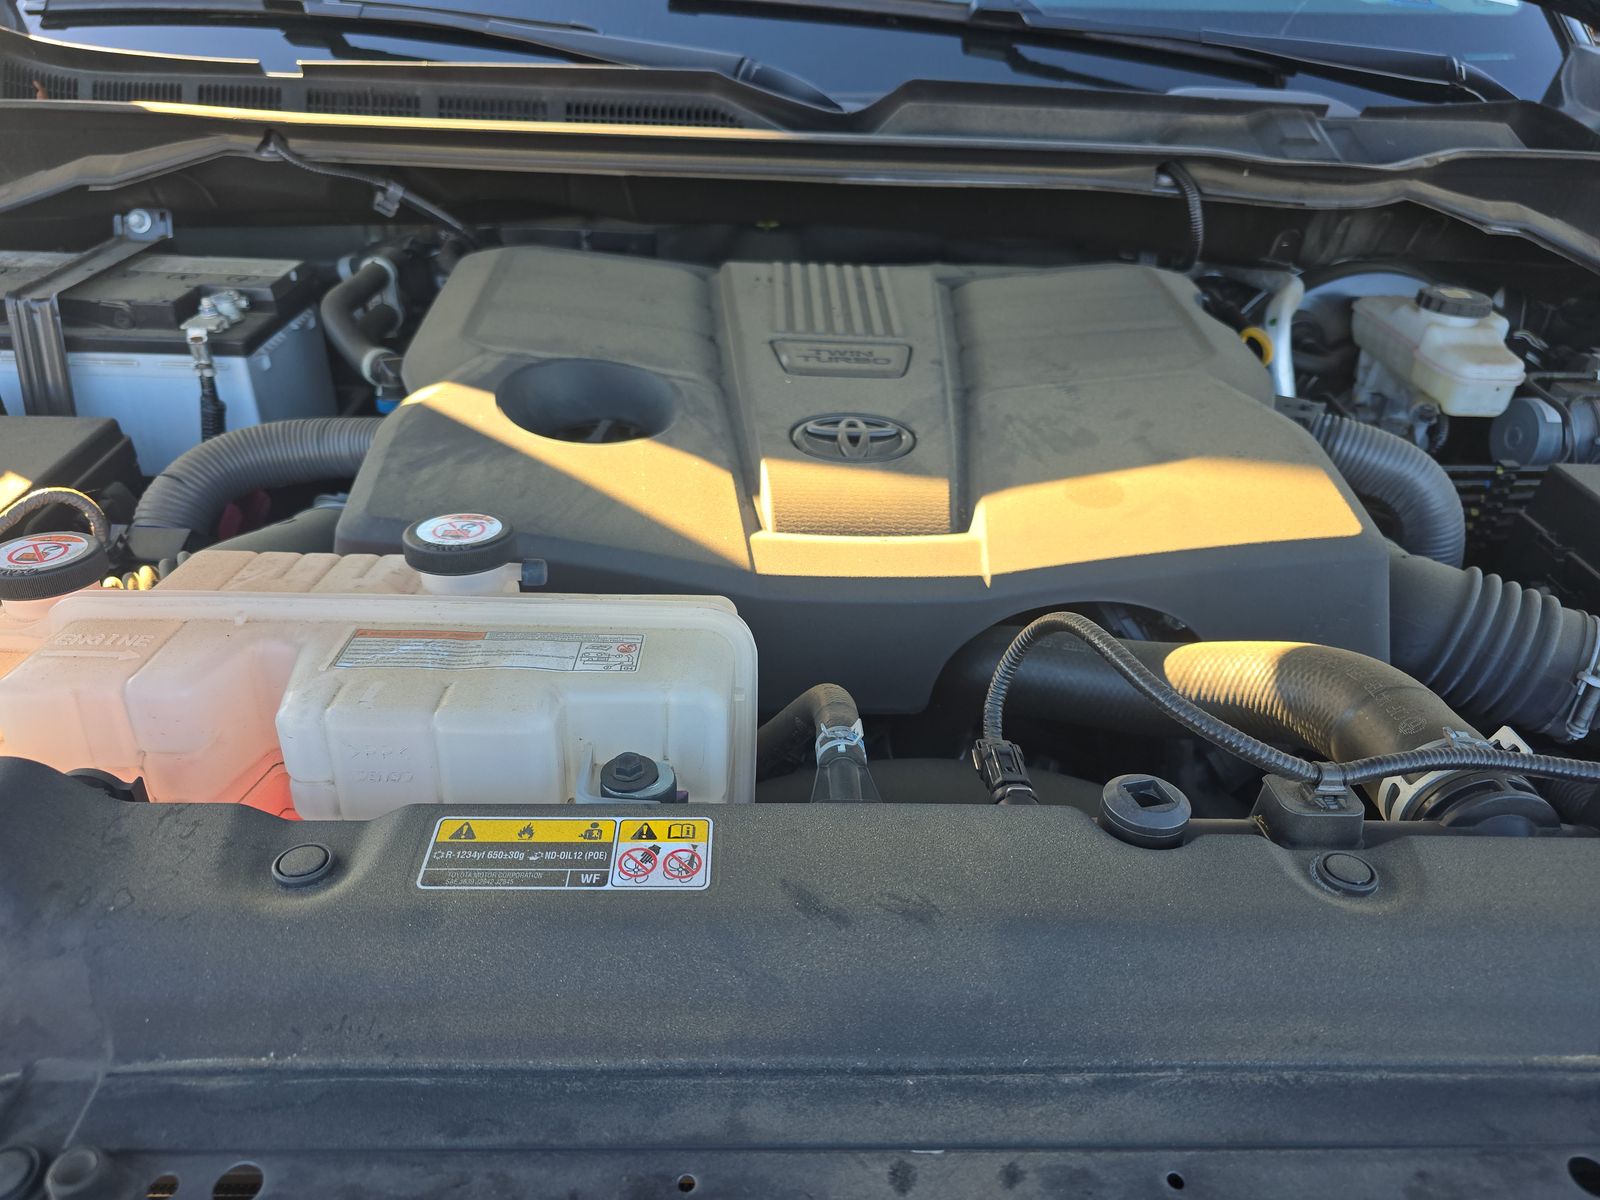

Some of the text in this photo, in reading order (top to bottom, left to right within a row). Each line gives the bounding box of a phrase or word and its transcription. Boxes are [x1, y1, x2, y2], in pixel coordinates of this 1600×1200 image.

[808, 348, 875, 358] TWIN
[795, 355, 891, 365] TURBO
[54, 633, 155, 648] ENGINE
[445, 850, 485, 861] R-1234yf
[487, 850, 525, 861] 650±30g
[584, 851, 608, 862] (POE)
[581, 873, 601, 884] WF
